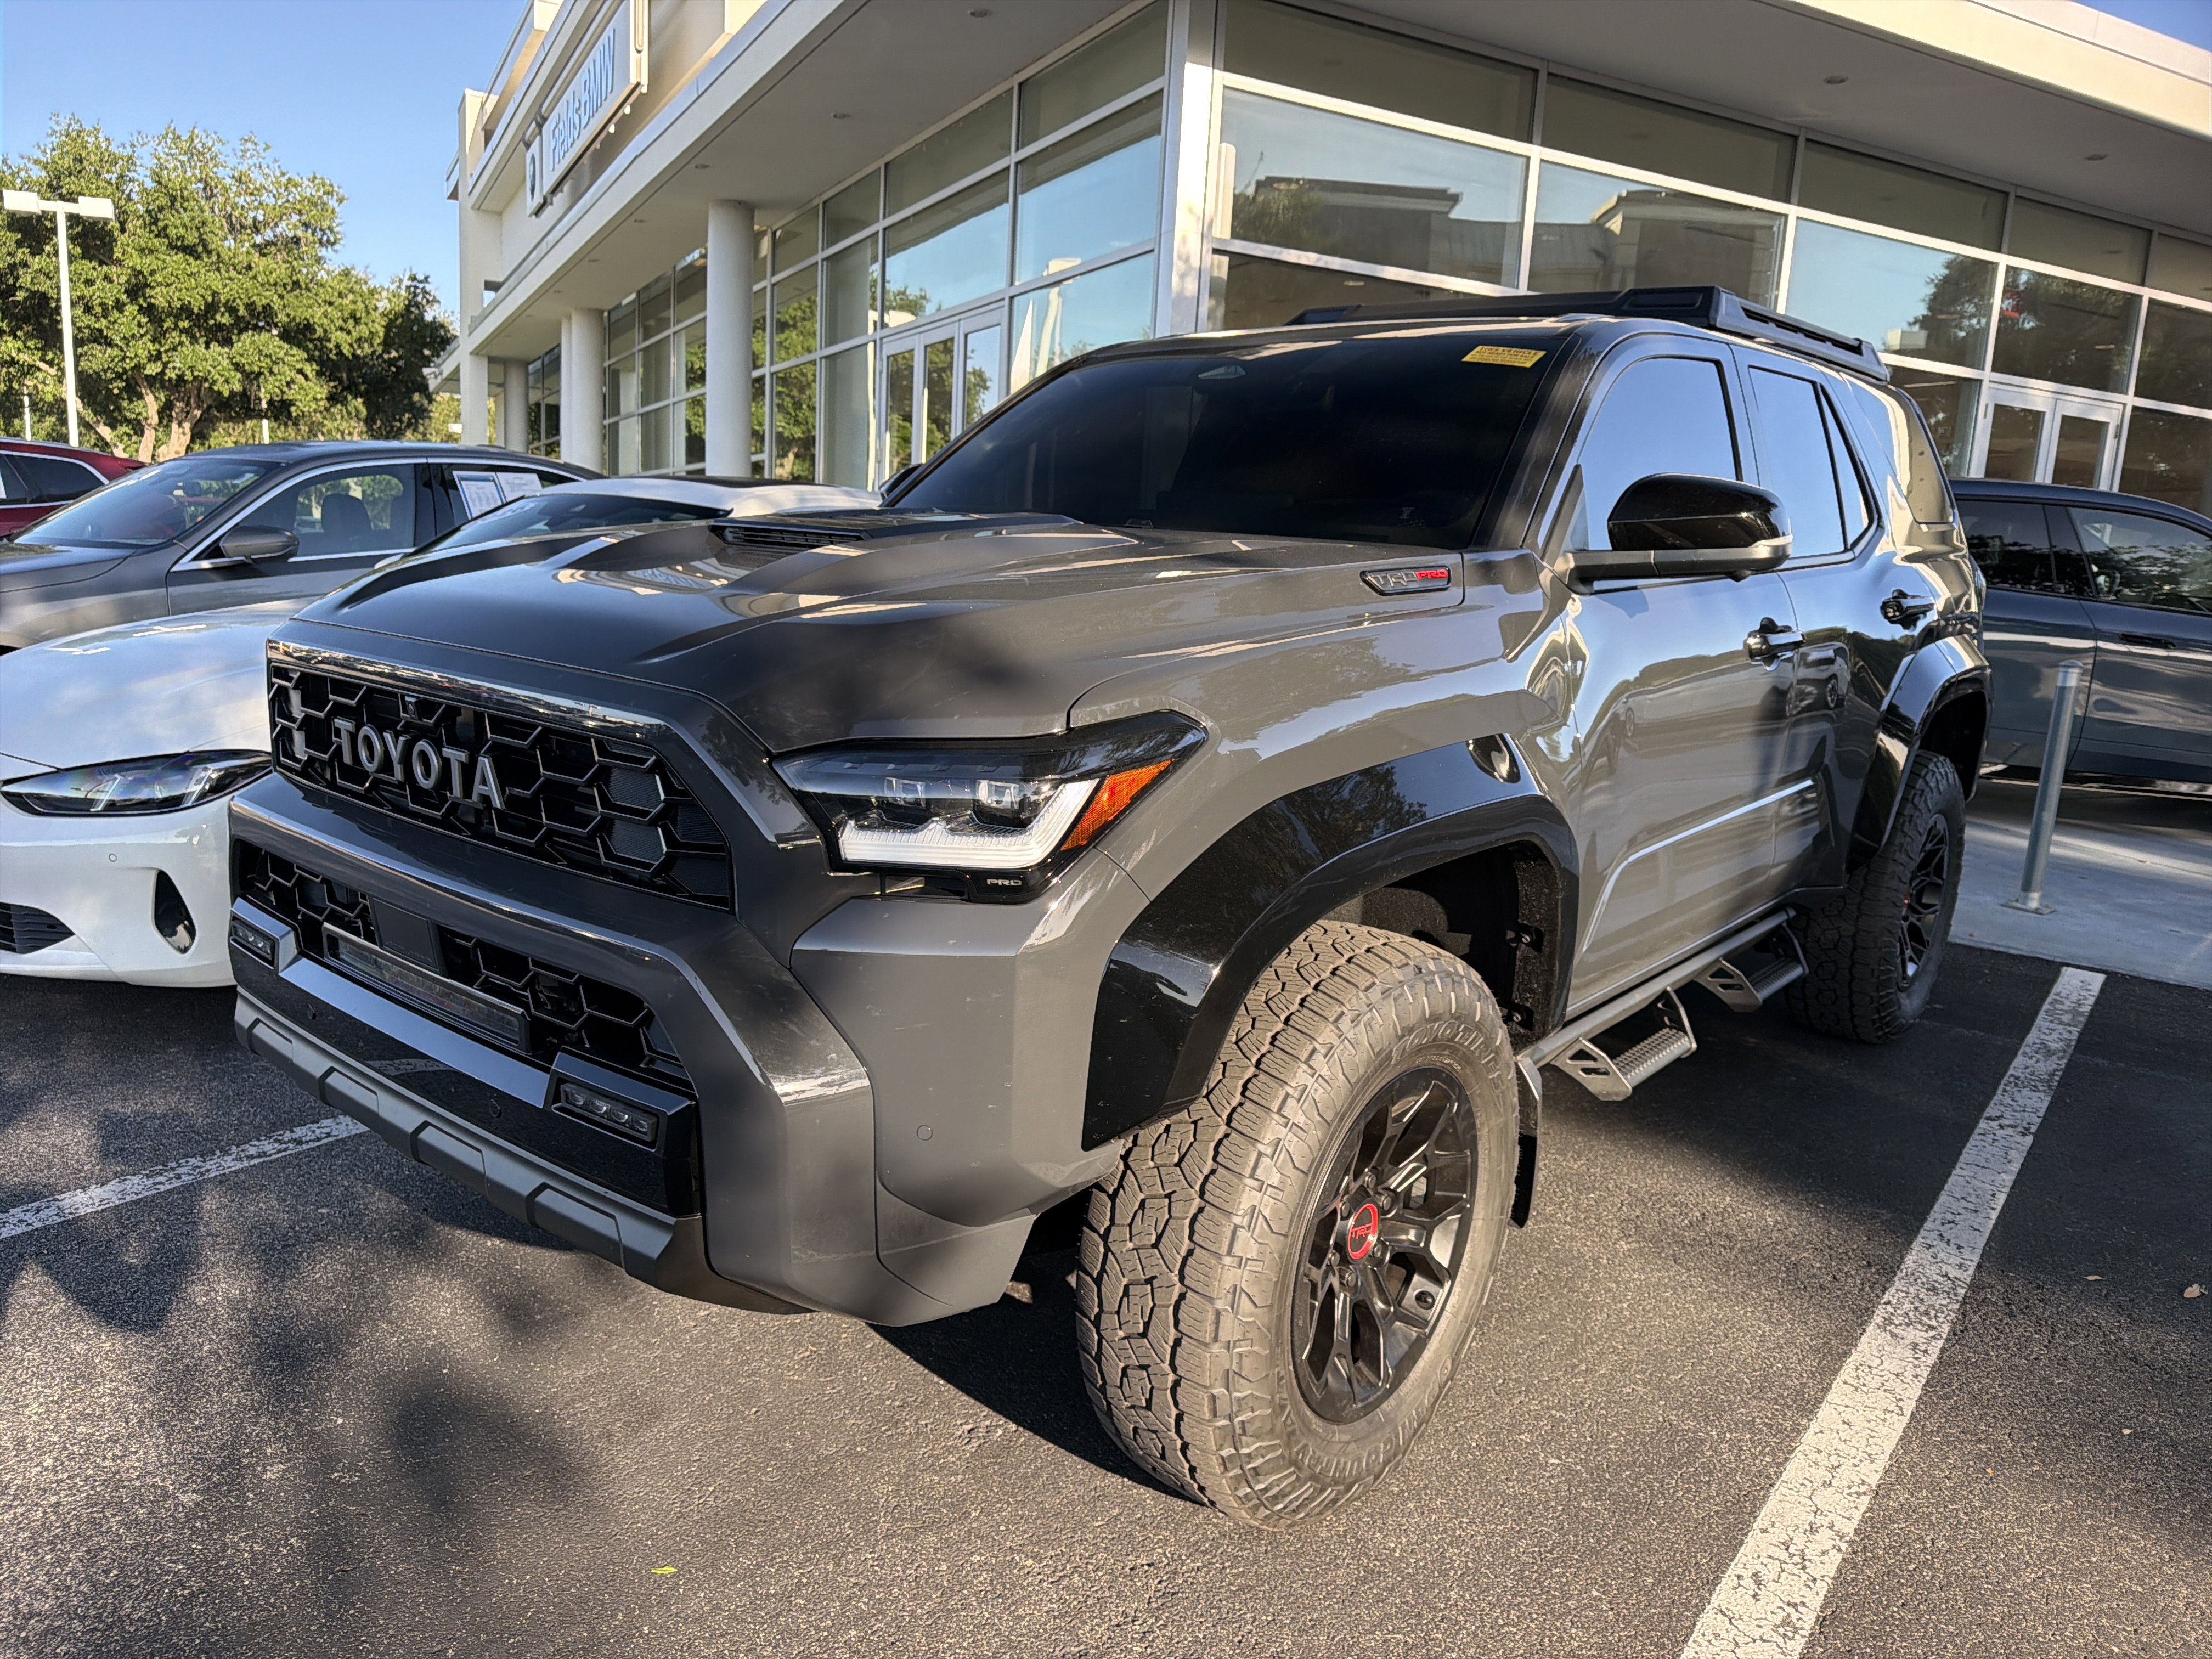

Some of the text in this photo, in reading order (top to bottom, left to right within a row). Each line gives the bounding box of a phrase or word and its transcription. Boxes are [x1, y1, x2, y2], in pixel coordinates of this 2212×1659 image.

[550, 28, 616, 172] Fields BMW
[1501, 348, 1541, 357] VEHICLE
[1372, 569, 1449, 588] TRD PRO
[333, 716, 507, 811] TOYOTA
[1391, 1020, 1458, 1065] TOYO
[1351, 1223, 1373, 1240] TRD
